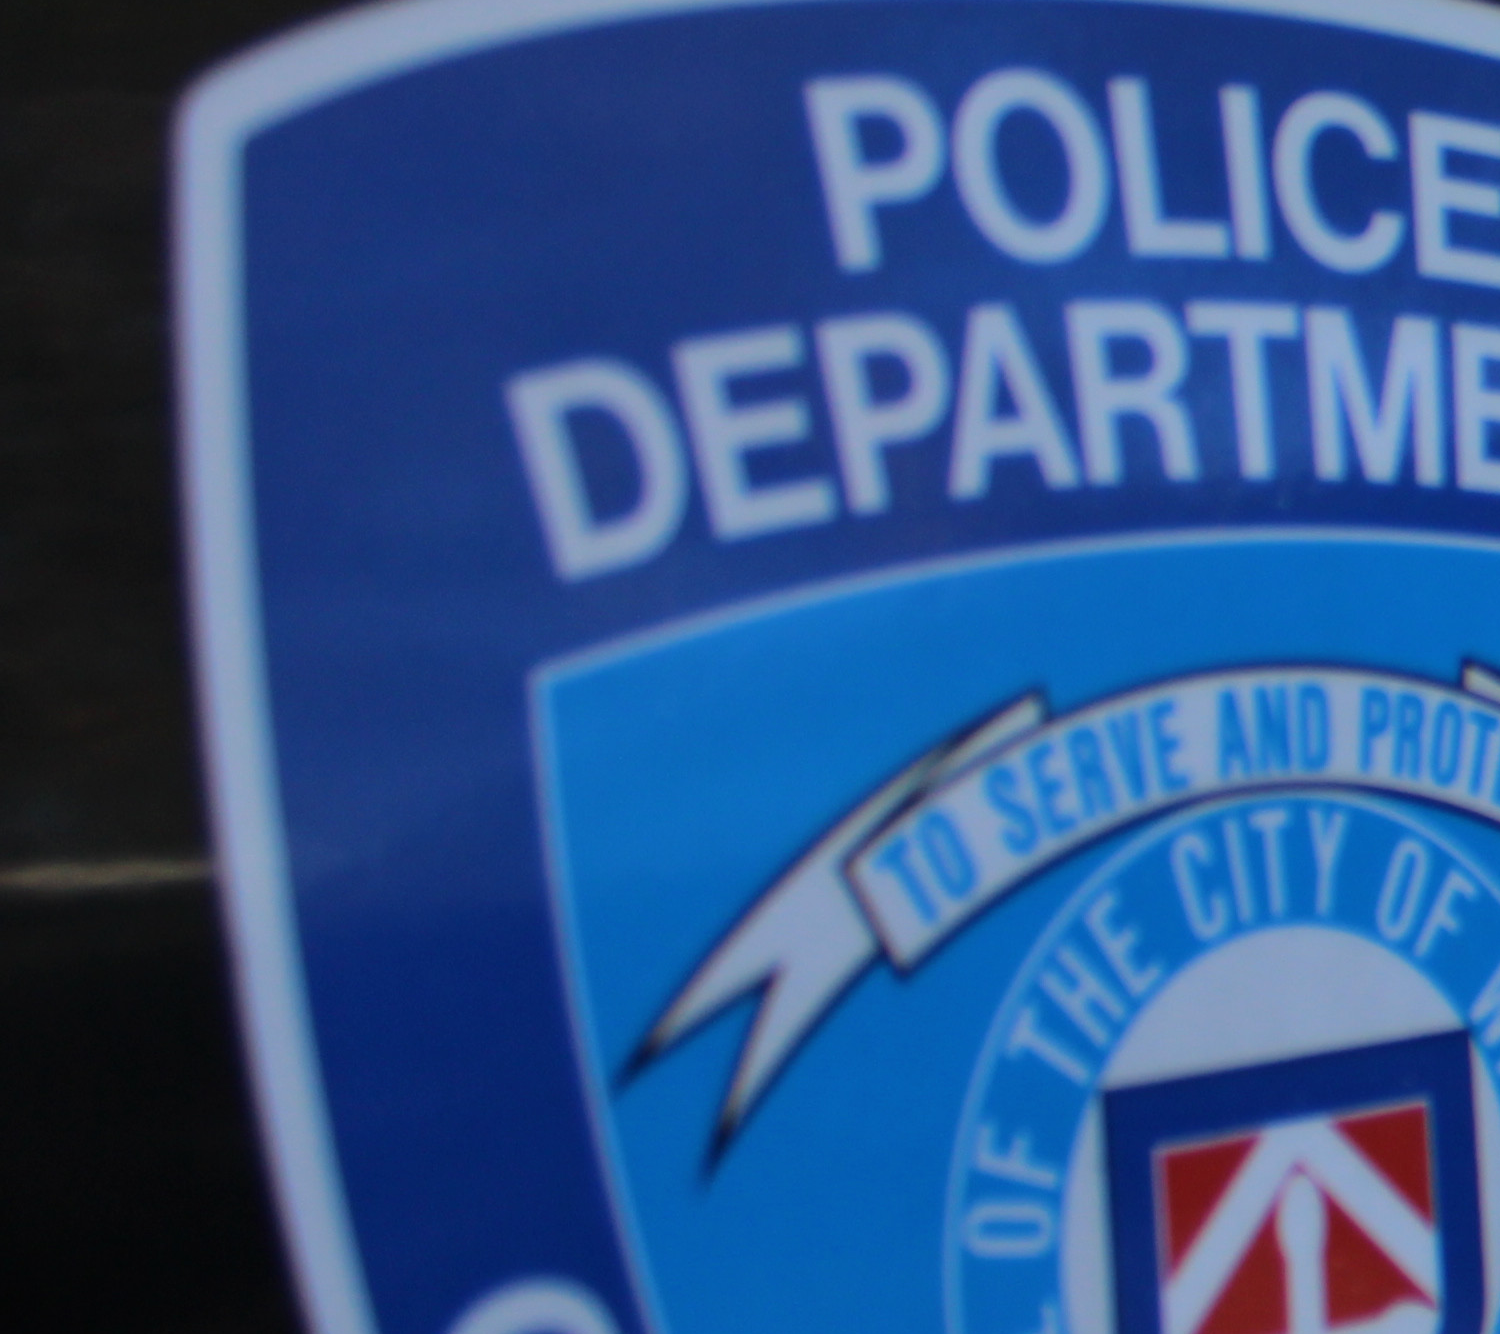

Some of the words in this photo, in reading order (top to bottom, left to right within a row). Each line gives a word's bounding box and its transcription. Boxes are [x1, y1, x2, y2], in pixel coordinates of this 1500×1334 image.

[872, 827, 977, 926] TO
[981, 698, 1189, 860] SERVE
[1216, 682, 1330, 777] AND
[1171, 808, 1345, 942] CITY
[1375, 838, 1477, 957] OF
[1007, 891, 1166, 1087] THE
[964, 1124, 1060, 1259] OF
